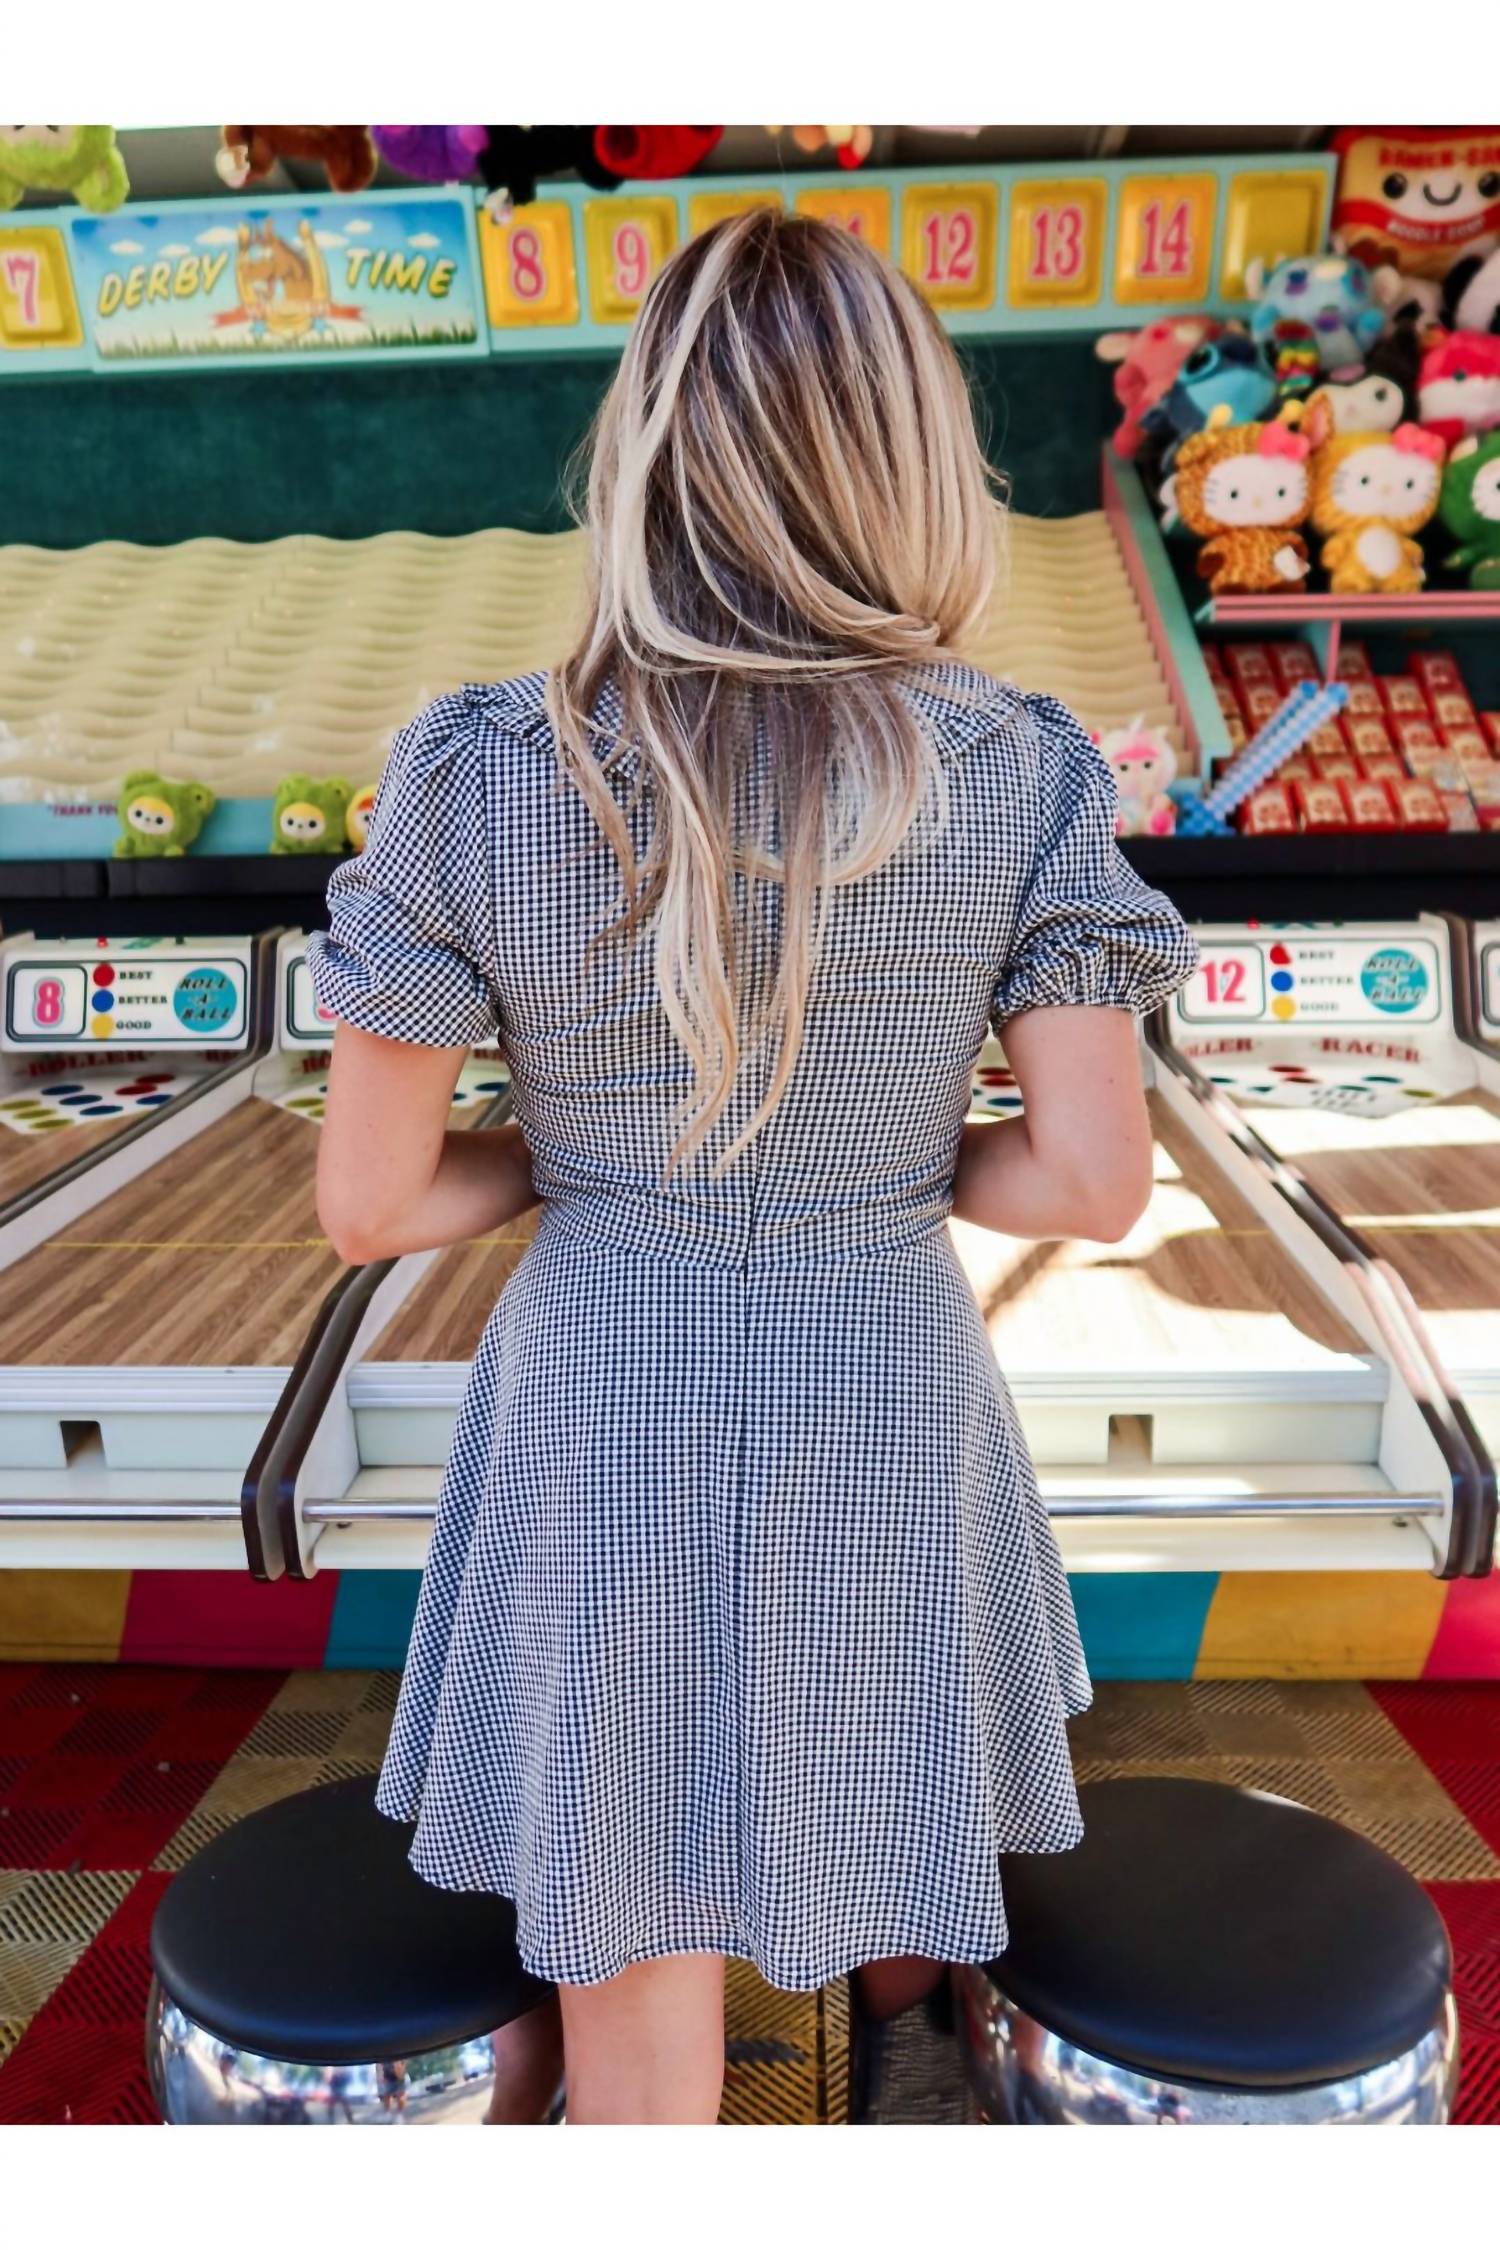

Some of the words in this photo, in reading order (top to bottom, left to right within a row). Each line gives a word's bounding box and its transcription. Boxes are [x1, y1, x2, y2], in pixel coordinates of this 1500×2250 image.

[613, 221, 651, 297] 9
[923, 212, 977, 285] 12
[1030, 206, 1084, 280] 13
[1138, 200, 1190, 276] 14
[97, 251, 229, 317] DERBY
[344, 248, 458, 298] TIME
[511, 228, 546, 302] 8
[3, 253, 37, 326] 7
[119, 971, 153, 980] BEST
[1299, 950, 1334, 959] BEST
[34, 978, 64, 1028] 8
[117, 995, 168, 1005] BETTER
[179, 977, 229, 990] ROLL
[1201, 959, 1246, 1003] 12
[116, 1020, 152, 1030] GOOD
[181, 1007, 232, 1020] BALL
[1320, 1038, 1421, 1062] RACER
